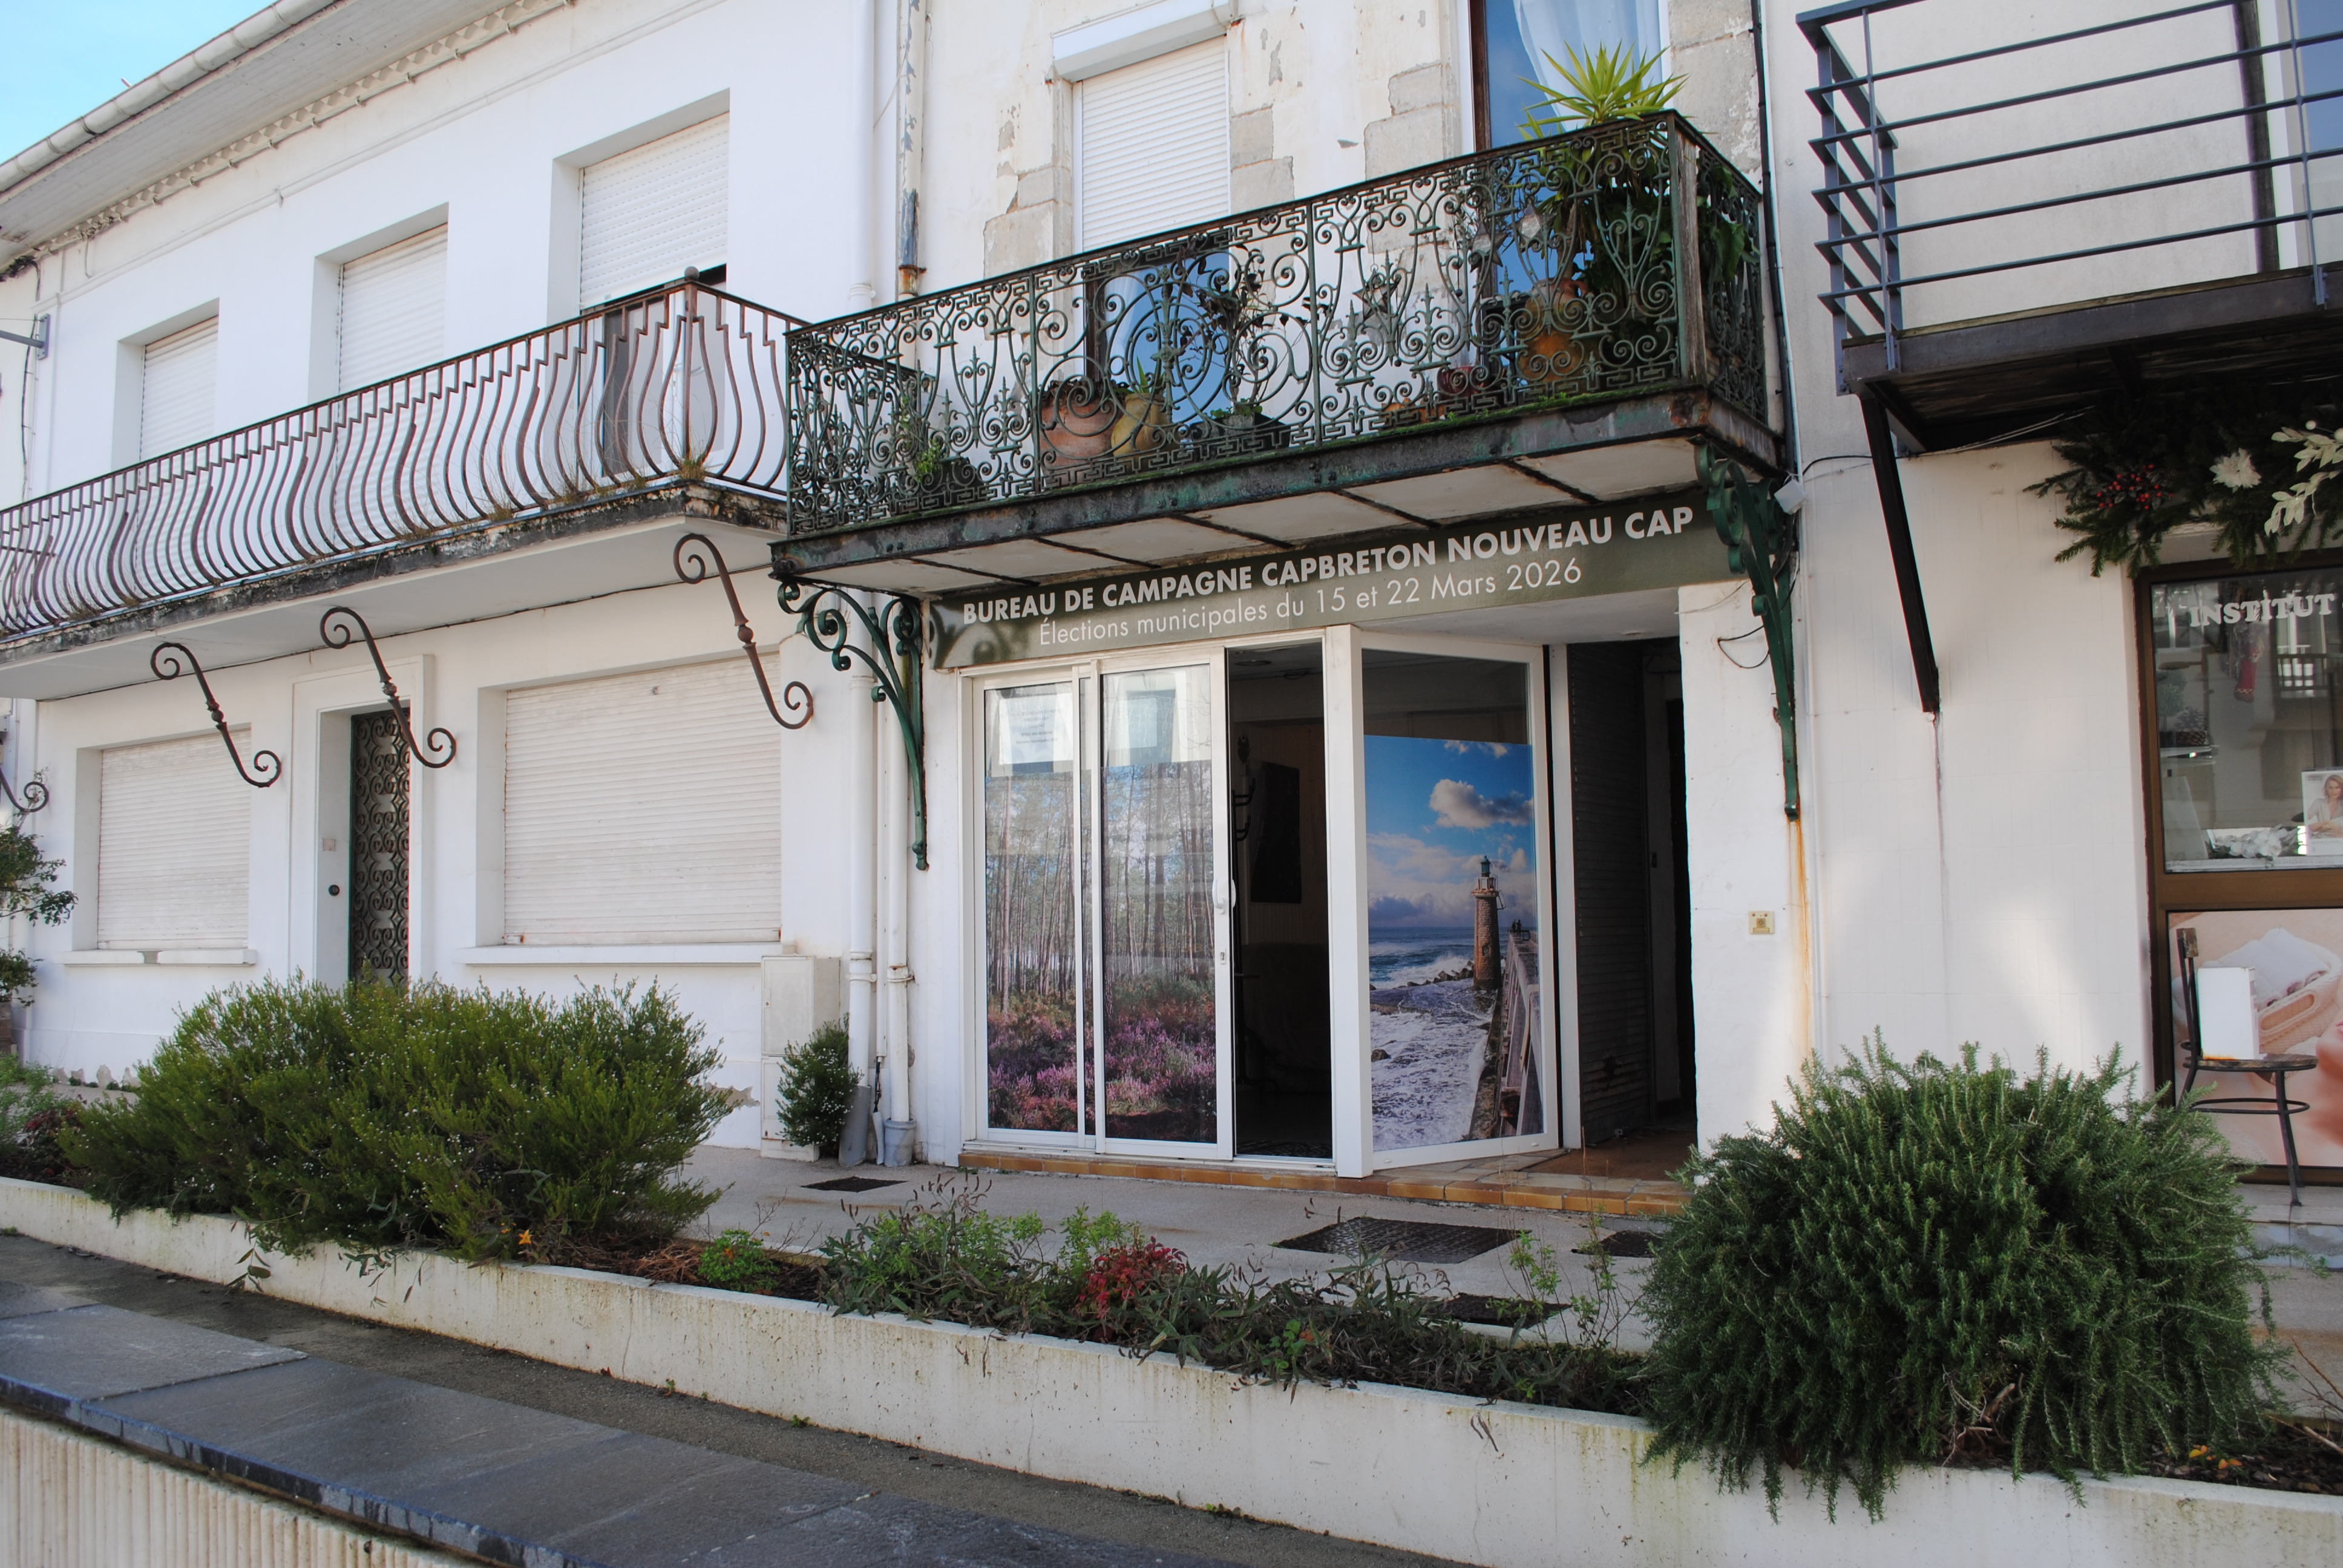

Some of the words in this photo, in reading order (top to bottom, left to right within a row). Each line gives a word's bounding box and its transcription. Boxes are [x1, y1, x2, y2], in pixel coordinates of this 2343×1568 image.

[963, 593, 1055, 625] BUREAU
[1065, 588, 1093, 612] DE
[1103, 566, 1252, 607] CAMPAGNE
[1262, 541, 1436, 586] CAPBRETON
[1448, 517, 1612, 563] NOUVEAU
[1625, 506, 1693, 539] CAP
[1040, 617, 1129, 645] Élections
[1138, 596, 1268, 634] municipales
[1276, 592, 1305, 618] du
[1317, 586, 1346, 613] 15
[1356, 586, 1378, 609] et
[1387, 577, 1420, 605] 22
[1431, 572, 1496, 600] Mars
[1506, 557, 1582, 591] 2026
[2189, 592, 2335, 627] INSTITUT
